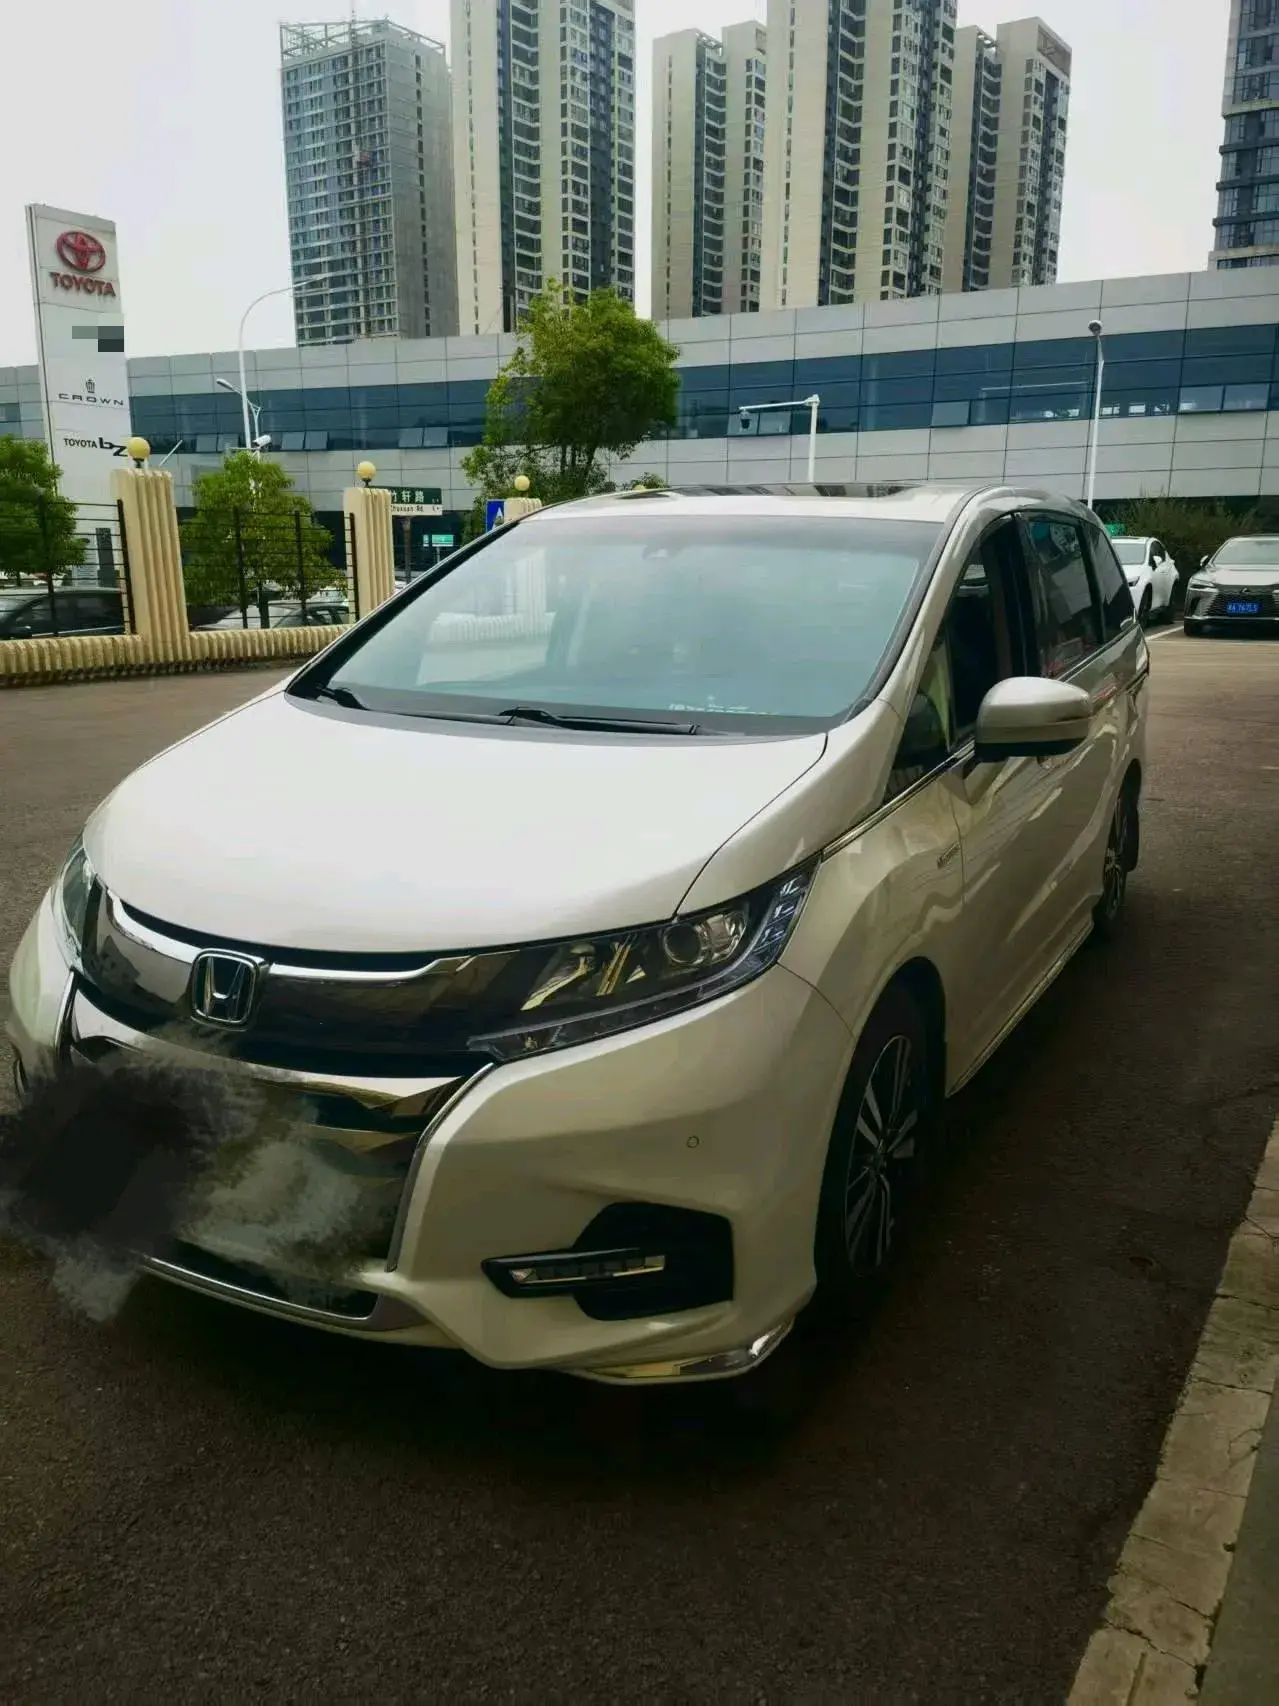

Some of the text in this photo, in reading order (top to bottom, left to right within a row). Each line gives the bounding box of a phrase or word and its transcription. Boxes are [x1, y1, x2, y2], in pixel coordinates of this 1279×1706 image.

[49, 271, 117, 297] TOYOTA
[58, 392, 124, 406] CROWN
[63, 438, 98, 449] TOYOTA
